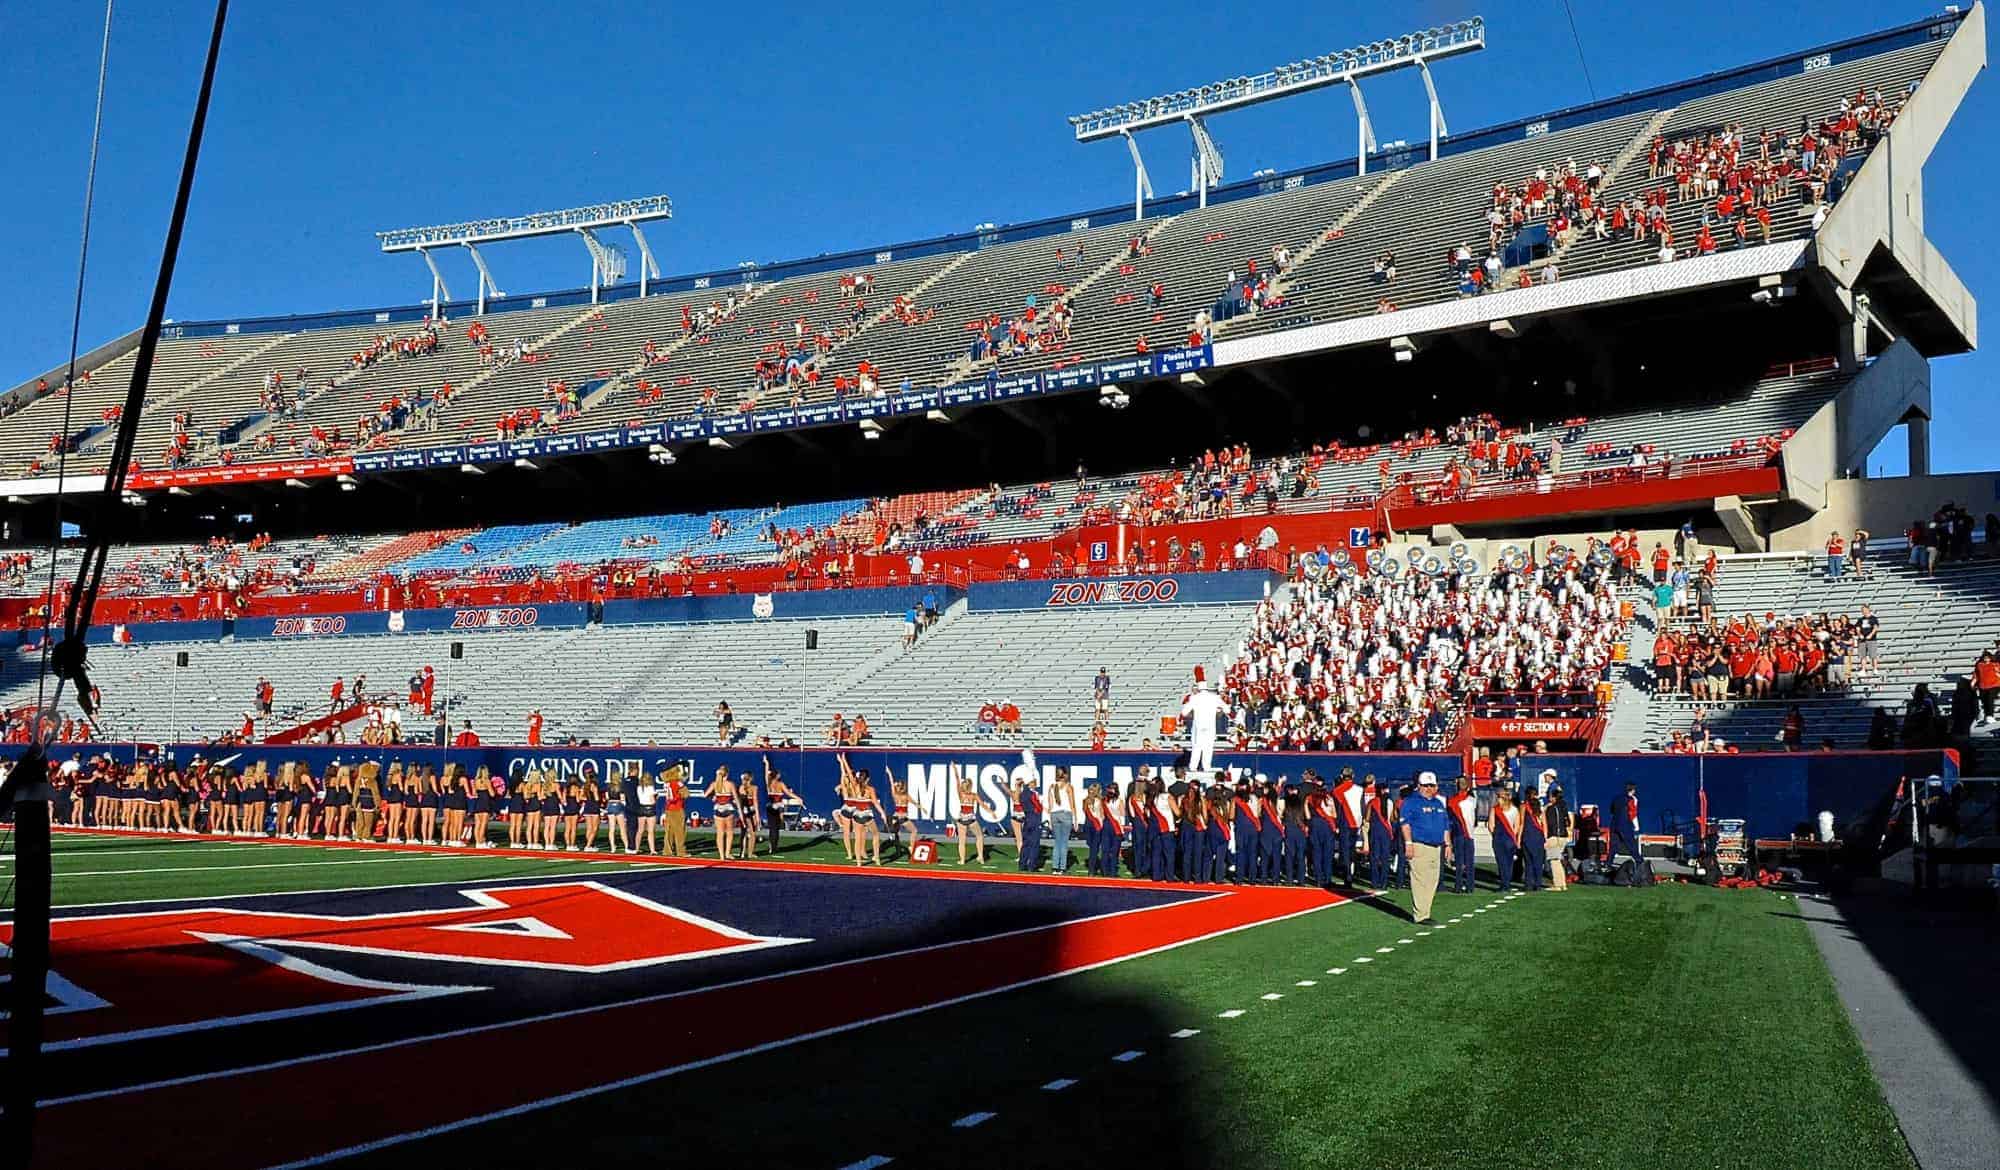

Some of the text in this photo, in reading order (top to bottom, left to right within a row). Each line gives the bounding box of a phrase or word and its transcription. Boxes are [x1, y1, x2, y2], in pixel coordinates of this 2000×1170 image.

[1163, 348, 1204, 362] Fiesta Bowl
[1138, 359, 1152, 367] Bowl
[1175, 361, 1193, 370] 2014
[1080, 367, 1094, 376] Bowl
[1021, 377, 1036, 386] Bowl
[968, 383, 986, 393] Bowl
[922, 391, 938, 400] Bowl
[870, 398, 888, 407] Bowl
[1046, 579, 1178, 607] ZONAZOO
[1523, 722, 1555, 732] SECTION
[913, 845, 931, 861] G
